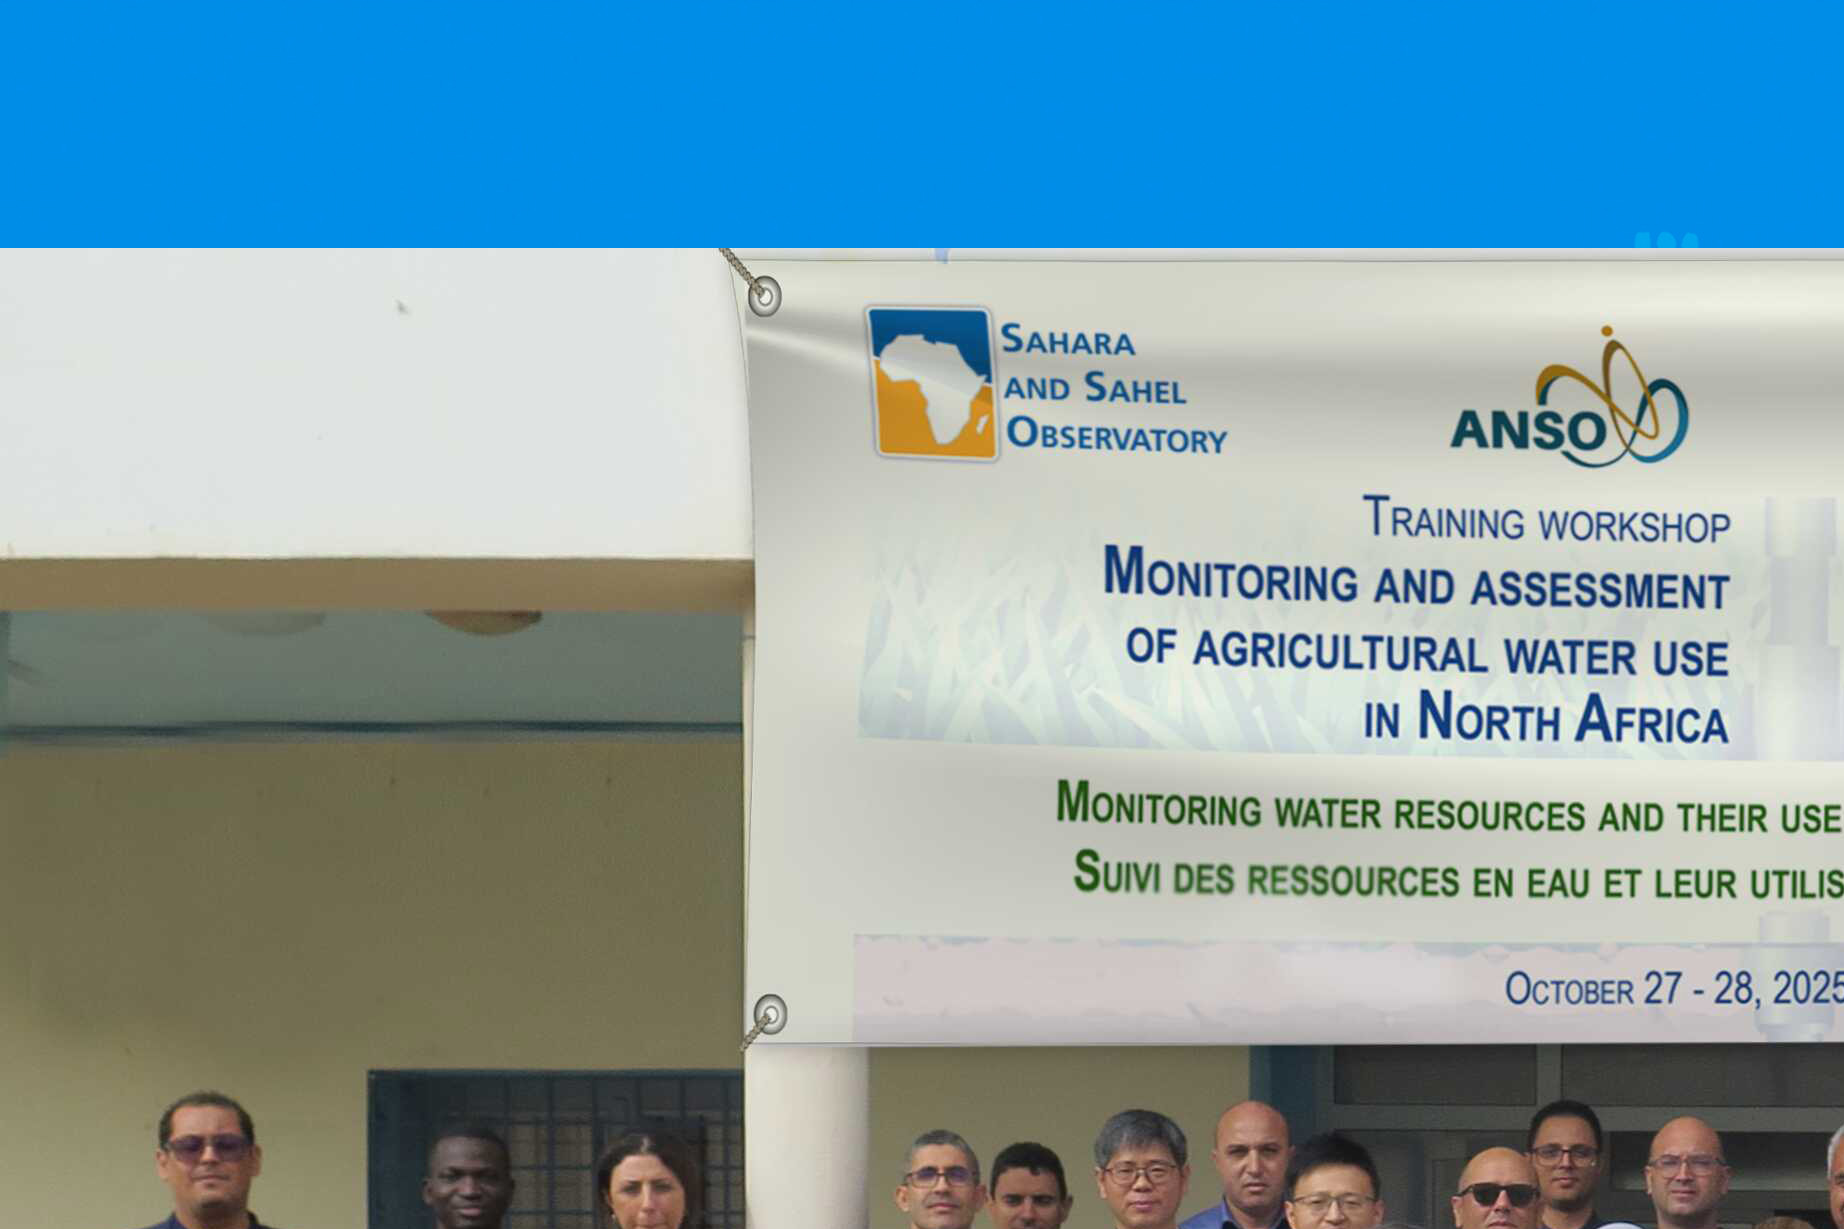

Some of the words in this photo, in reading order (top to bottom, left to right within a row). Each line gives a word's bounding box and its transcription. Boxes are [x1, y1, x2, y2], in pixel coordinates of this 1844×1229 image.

[1002, 323, 1136, 355] SAHARA
[1005, 378, 1069, 400] AND
[1085, 371, 1187, 404] SAHEL
[1007, 416, 1227, 454] OBSERVATORY
[1450, 410, 1606, 451] ANSO
[1363, 494, 1524, 540] TRAINING
[1538, 511, 1731, 543] WORKSHOP
[1105, 544, 1358, 602] MONITORING
[1374, 568, 1455, 604] AND
[1470, 571, 1731, 609] ASSESSMENT
[1126, 627, 1177, 663] OF
[1193, 630, 1488, 673] AGRICULTURAL
[1504, 638, 1637, 675] WATER
[1654, 641, 1729, 677] USE
[1365, 702, 1399, 738] IN
[1420, 689, 1560, 741] NORTH
[1574, 692, 1729, 744] AFRICA
[1057, 779, 1261, 827] MONITORING
[1275, 798, 1381, 829] WATER
[1395, 800, 1585, 832] RESOURCES
[1598, 803, 1664, 832] AND
[1677, 803, 1768, 832] THEIR
[1782, 804, 1842, 833] USE
[1074, 849, 1160, 893] SUIVI
[1174, 863, 1234, 895] DES
[1249, 865, 1459, 897] RESSOURCES
[1474, 868, 1513, 898] EN
[1528, 869, 1589, 898] EAU
[1605, 869, 1642, 898] ET
[1656, 869, 1737, 899] LEUR
[1506, 971, 1634, 1005] OCTOBER
[1644, 970, 1682, 1004] 27
[1715, 970, 1760, 1010] 28,
